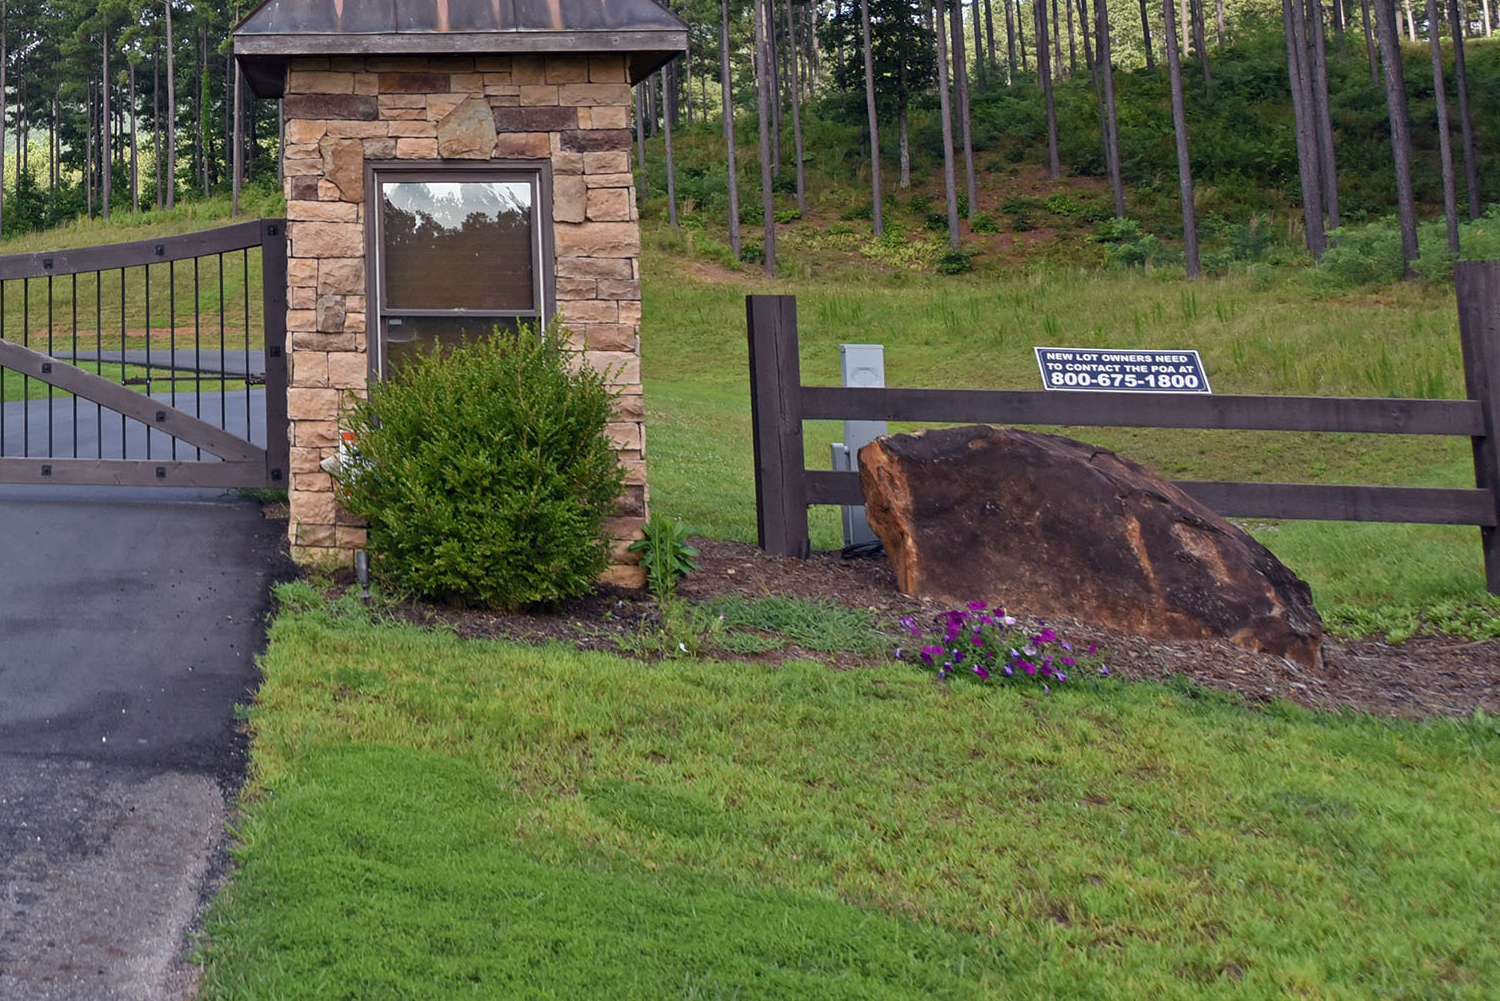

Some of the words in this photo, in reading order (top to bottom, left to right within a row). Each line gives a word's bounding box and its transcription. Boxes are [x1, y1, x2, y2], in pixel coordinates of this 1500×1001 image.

[1046, 353, 1073, 361] NEW
[1076, 353, 1098, 361] LOT
[1101, 354, 1152, 363] OWNERS
[1155, 354, 1188, 363] NEED
[1065, 363, 1121, 372] CONTACT
[1124, 365, 1148, 373] THE
[1151, 365, 1177, 373] POA
[1051, 372, 1199, 388] 800-675-1800
